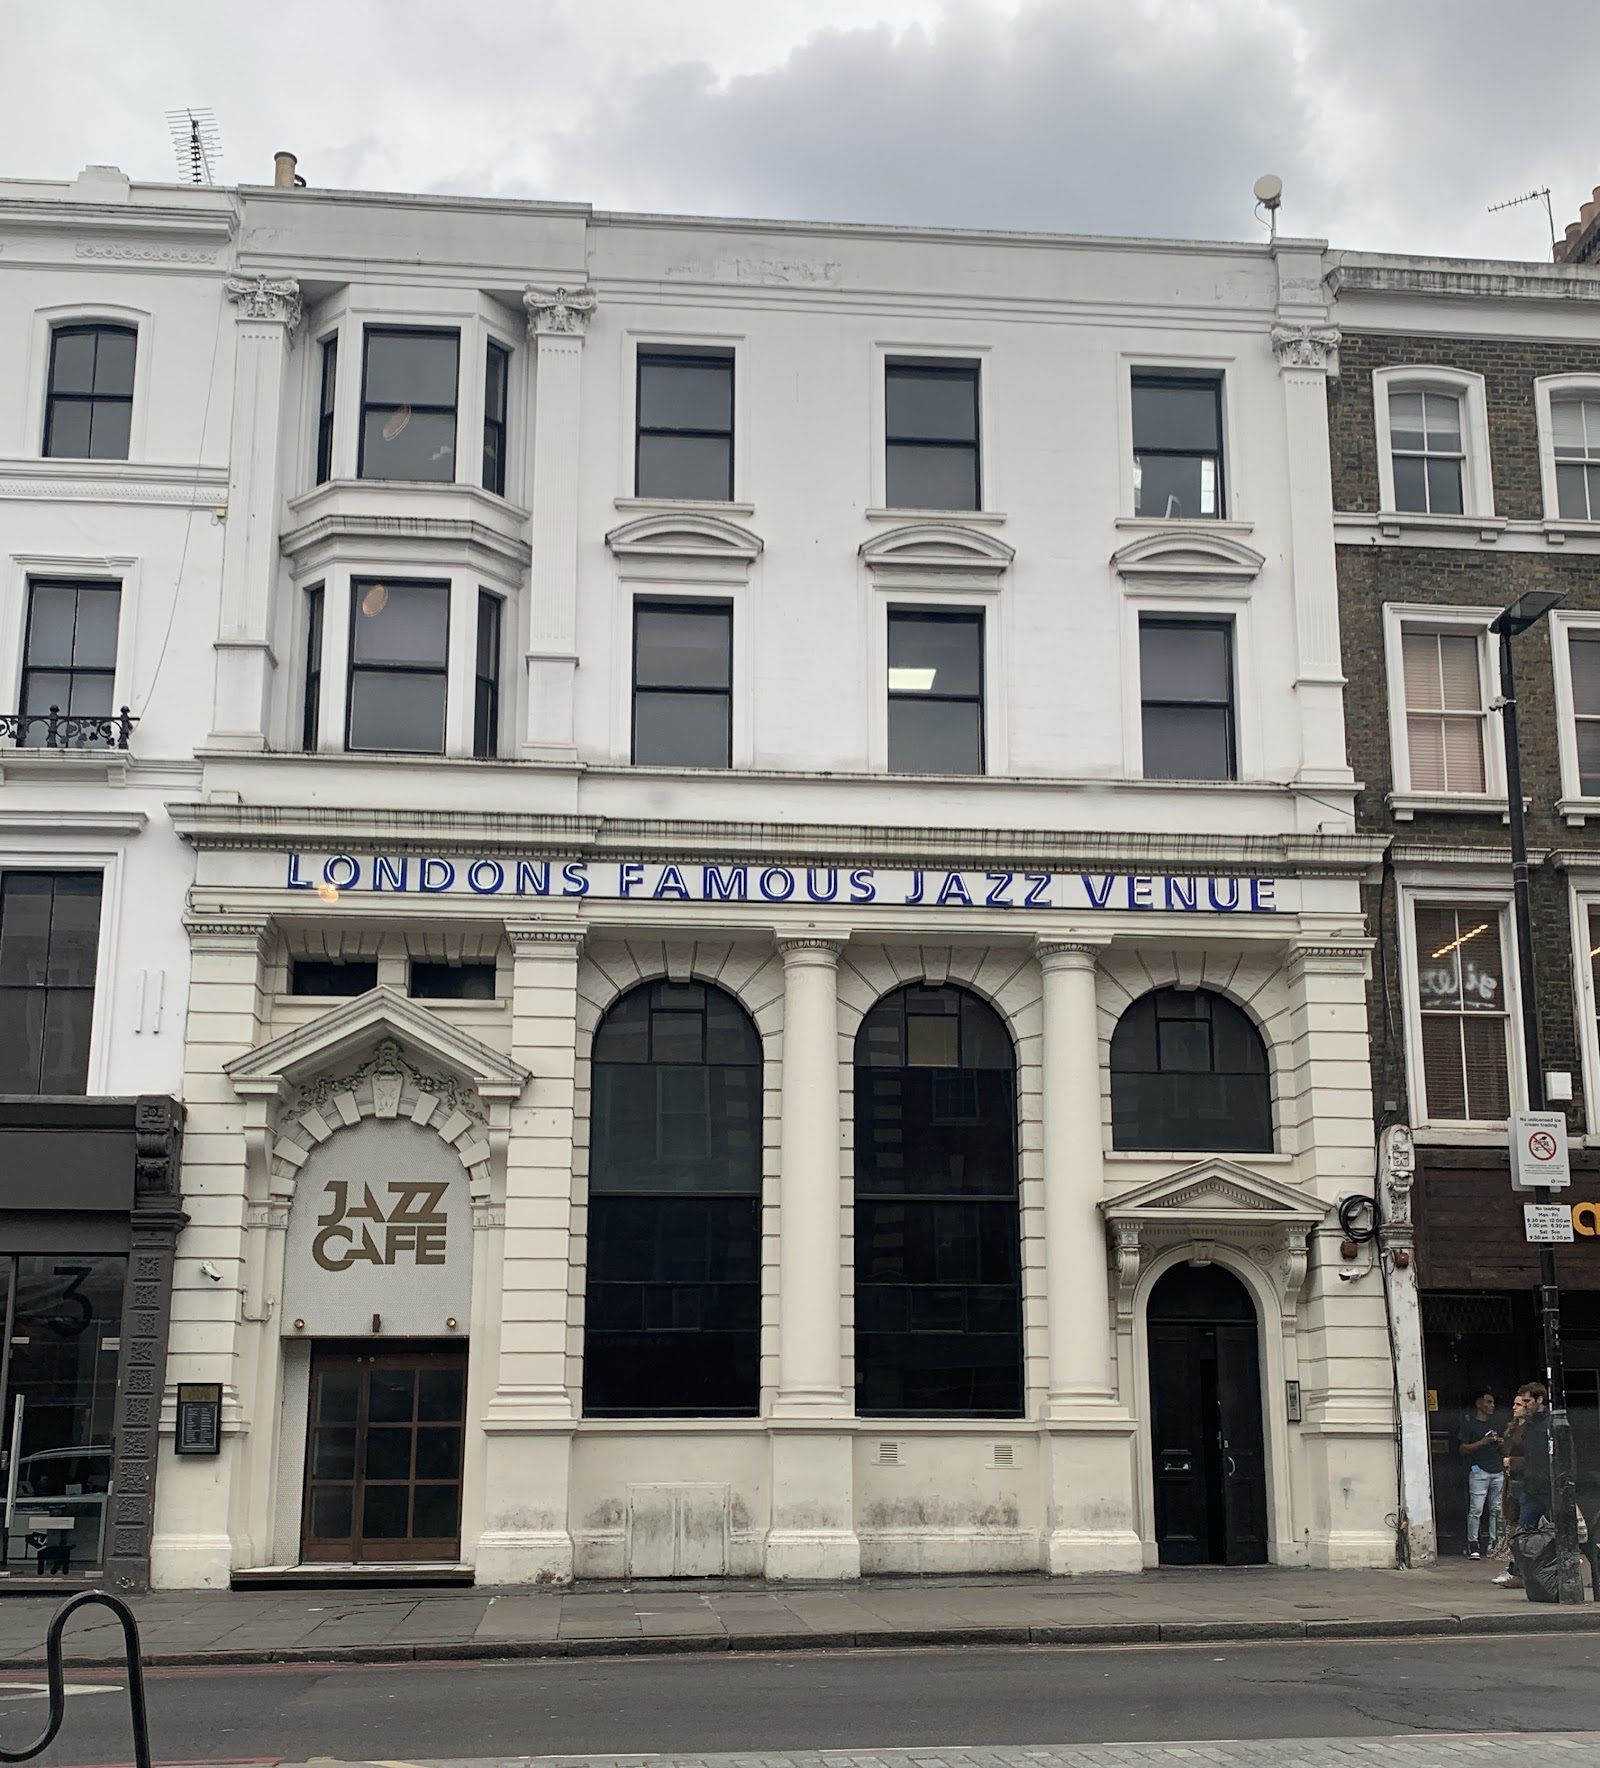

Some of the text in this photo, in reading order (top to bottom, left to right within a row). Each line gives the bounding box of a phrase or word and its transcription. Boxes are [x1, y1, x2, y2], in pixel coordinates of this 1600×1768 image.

[287, 853, 1277, 912] LONDONS FAMOUS JAZZ VENUE
[317, 1180, 450, 1226] JAZZ
[312, 1223, 447, 1272] CAFE
[52, 1266, 94, 1336] 3
